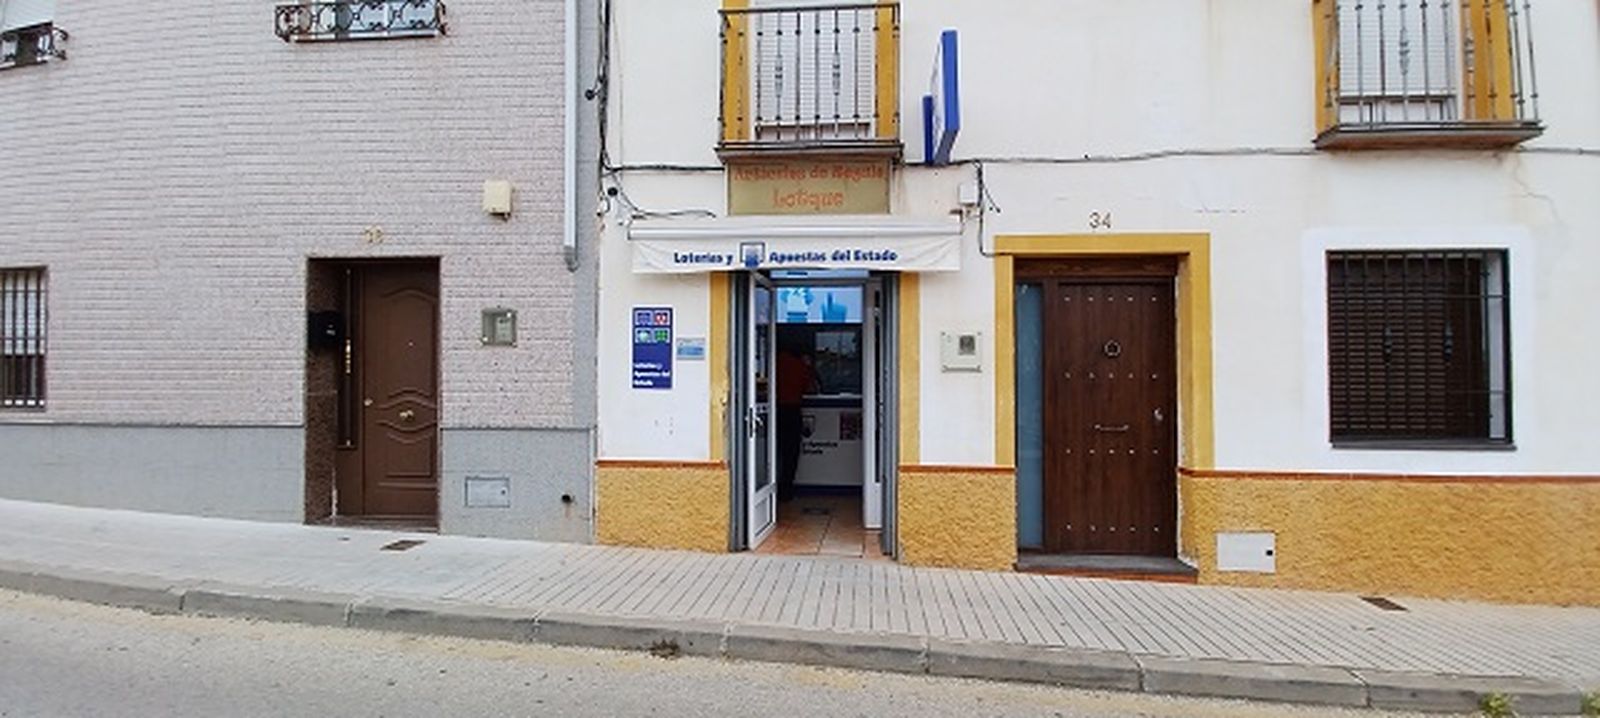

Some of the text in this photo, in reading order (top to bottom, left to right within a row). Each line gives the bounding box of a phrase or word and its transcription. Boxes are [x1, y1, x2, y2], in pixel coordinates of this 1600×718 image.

[1089, 212, 1111, 229] 34
[726, 254, 734, 266] y
[769, 251, 827, 264] Apuestas
[832, 250, 851, 261] del
[854, 250, 898, 261] Estado
